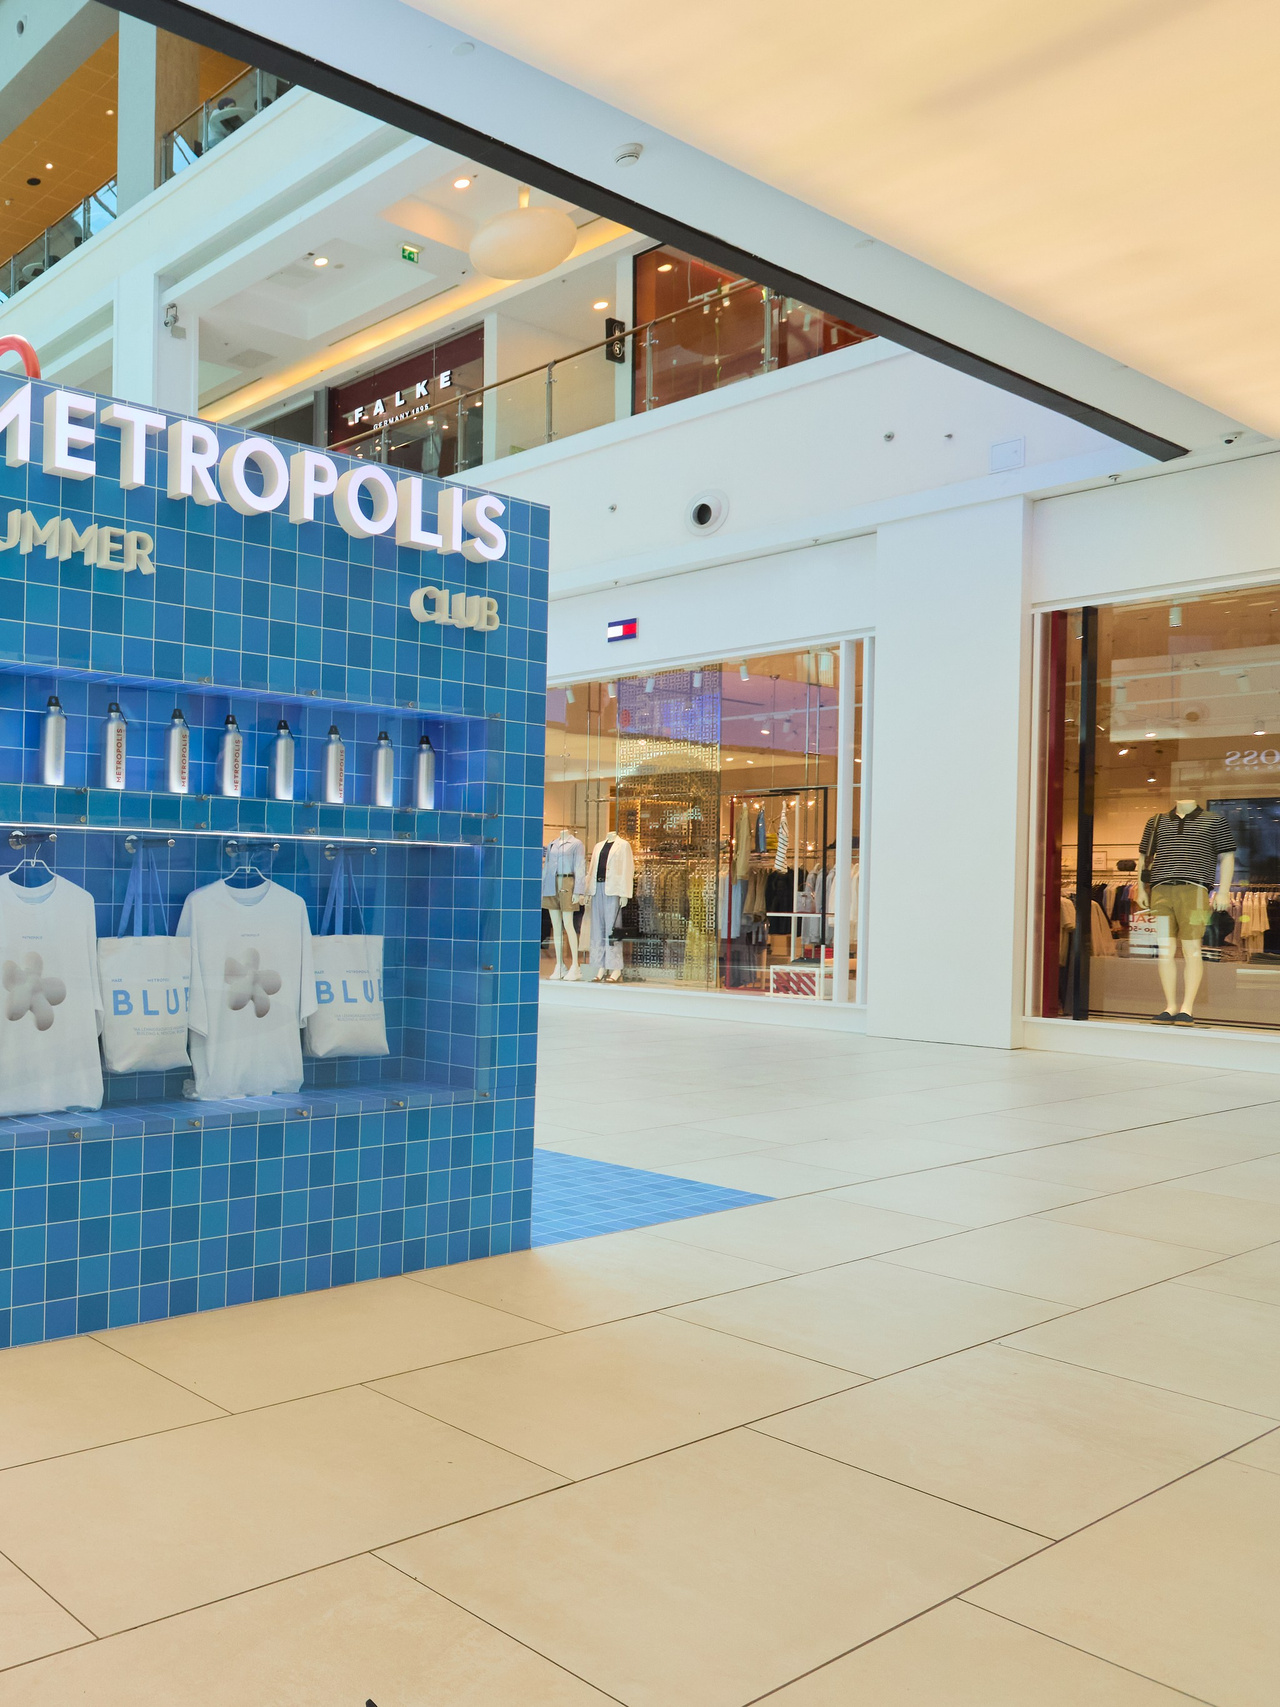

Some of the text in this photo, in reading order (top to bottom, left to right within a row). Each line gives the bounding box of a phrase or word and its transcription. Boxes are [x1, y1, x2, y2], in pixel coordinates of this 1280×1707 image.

[353, 370, 452, 424] FALKE
[373, 410, 411, 430] GERMANY
[410, 586, 500, 631] CLUB
